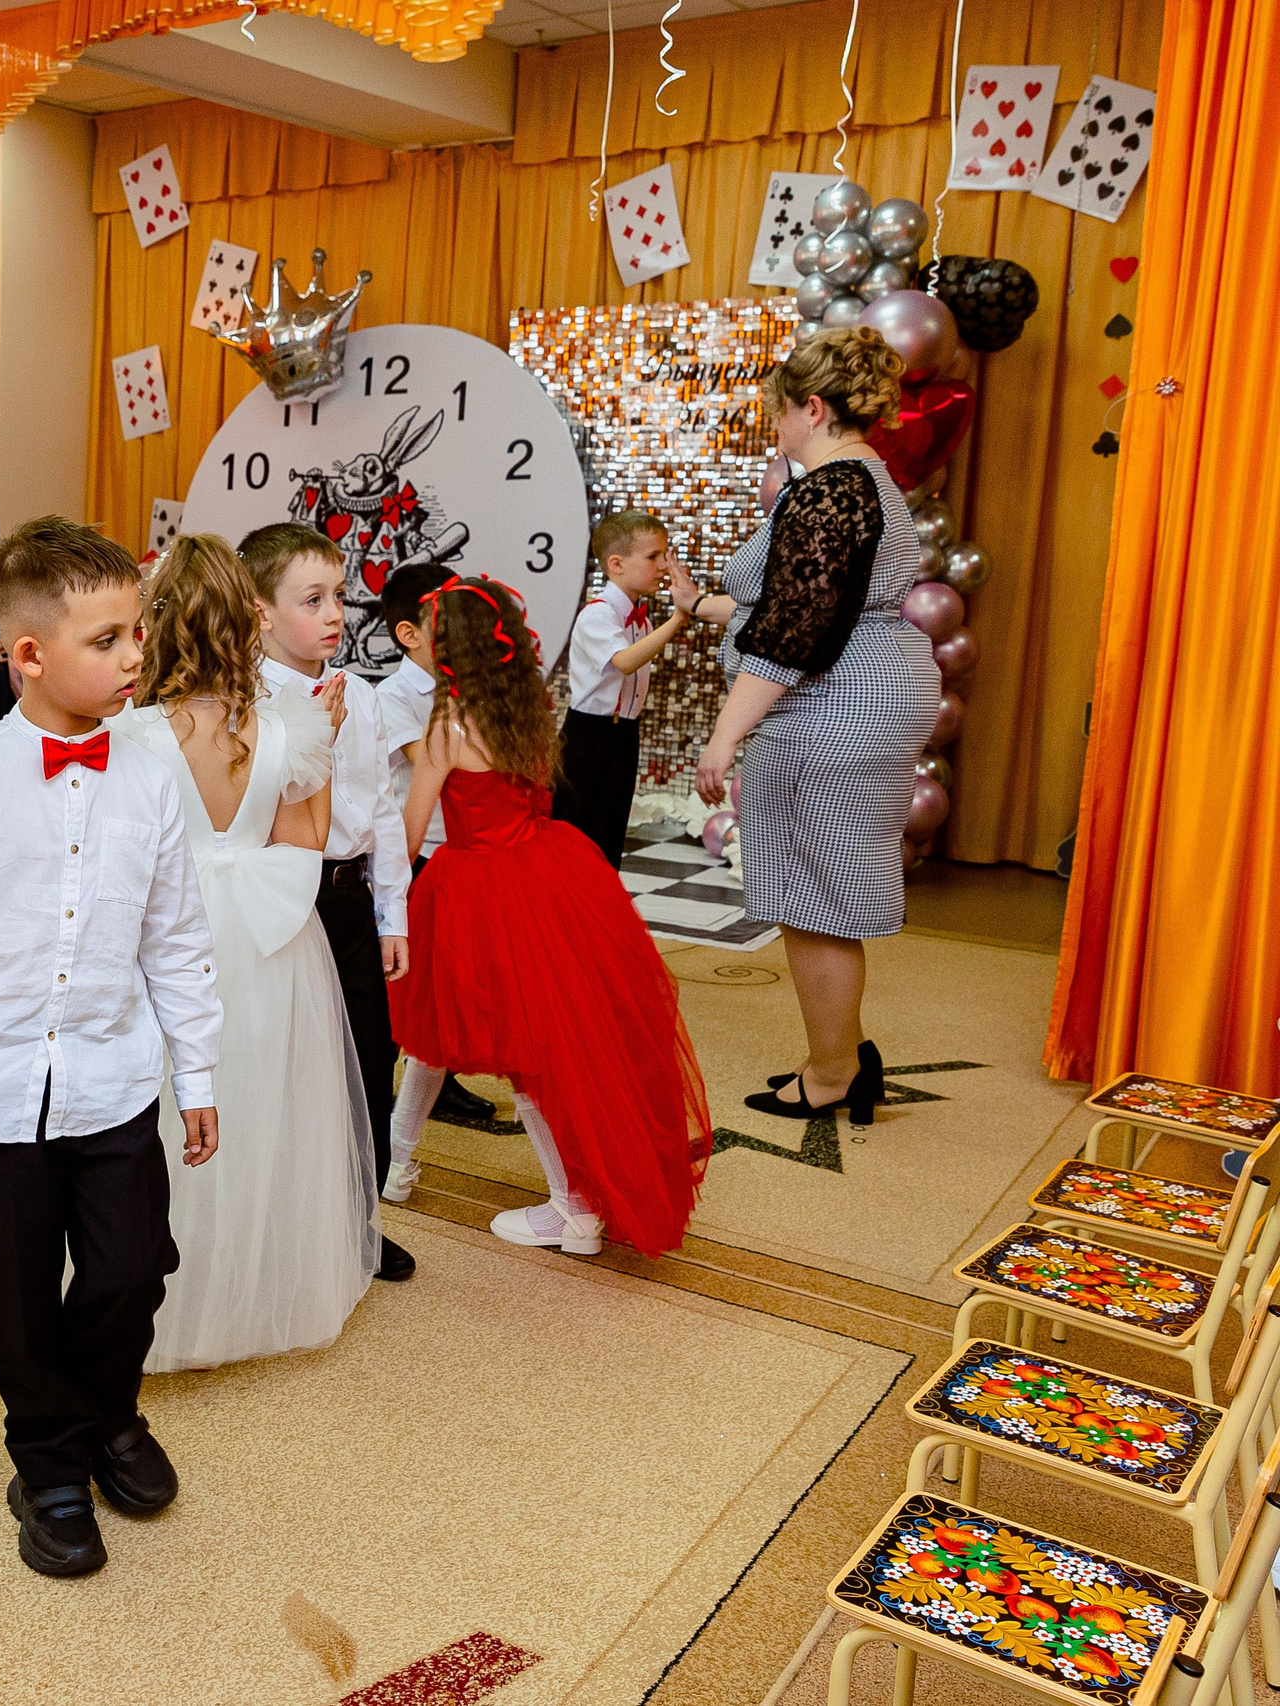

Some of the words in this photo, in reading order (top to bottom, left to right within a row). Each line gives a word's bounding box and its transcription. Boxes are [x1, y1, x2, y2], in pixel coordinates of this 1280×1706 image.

[359, 355, 411, 397] 12
[452, 380, 467, 421] 1
[222, 452, 270, 490] 10
[505, 439, 534, 480] 2
[525, 532, 554, 573] 3
